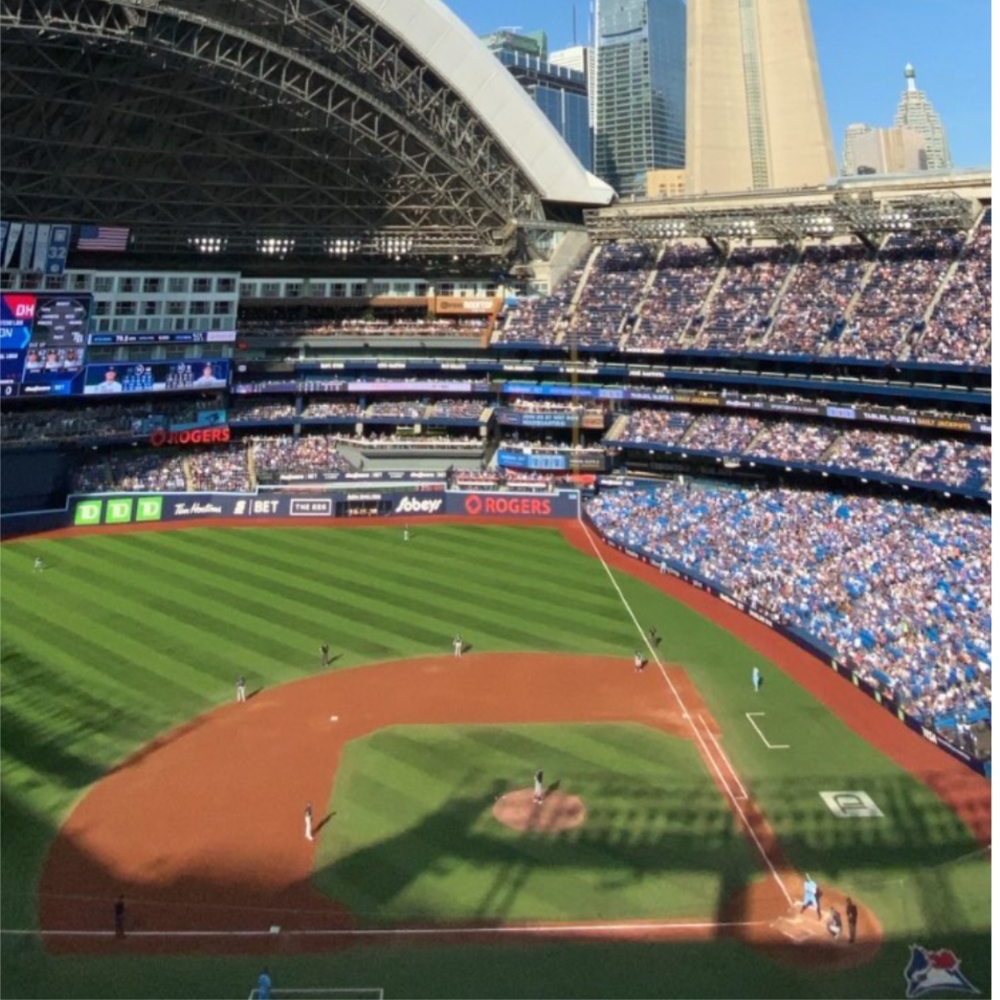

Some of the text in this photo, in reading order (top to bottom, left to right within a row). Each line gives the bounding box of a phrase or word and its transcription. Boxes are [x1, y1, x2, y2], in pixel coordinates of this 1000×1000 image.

[16, 304, 35, 317] DH
[169, 425, 231, 444] ROGERS
[80, 505, 98, 519] TD
[111, 503, 128, 517] TD
[142, 502, 159, 516] TD
[174, 502, 222, 515] Tim Hortons
[253, 500, 279, 514] BET
[295, 503, 310, 511] THE
[485, 497, 551, 515] ROGERS
